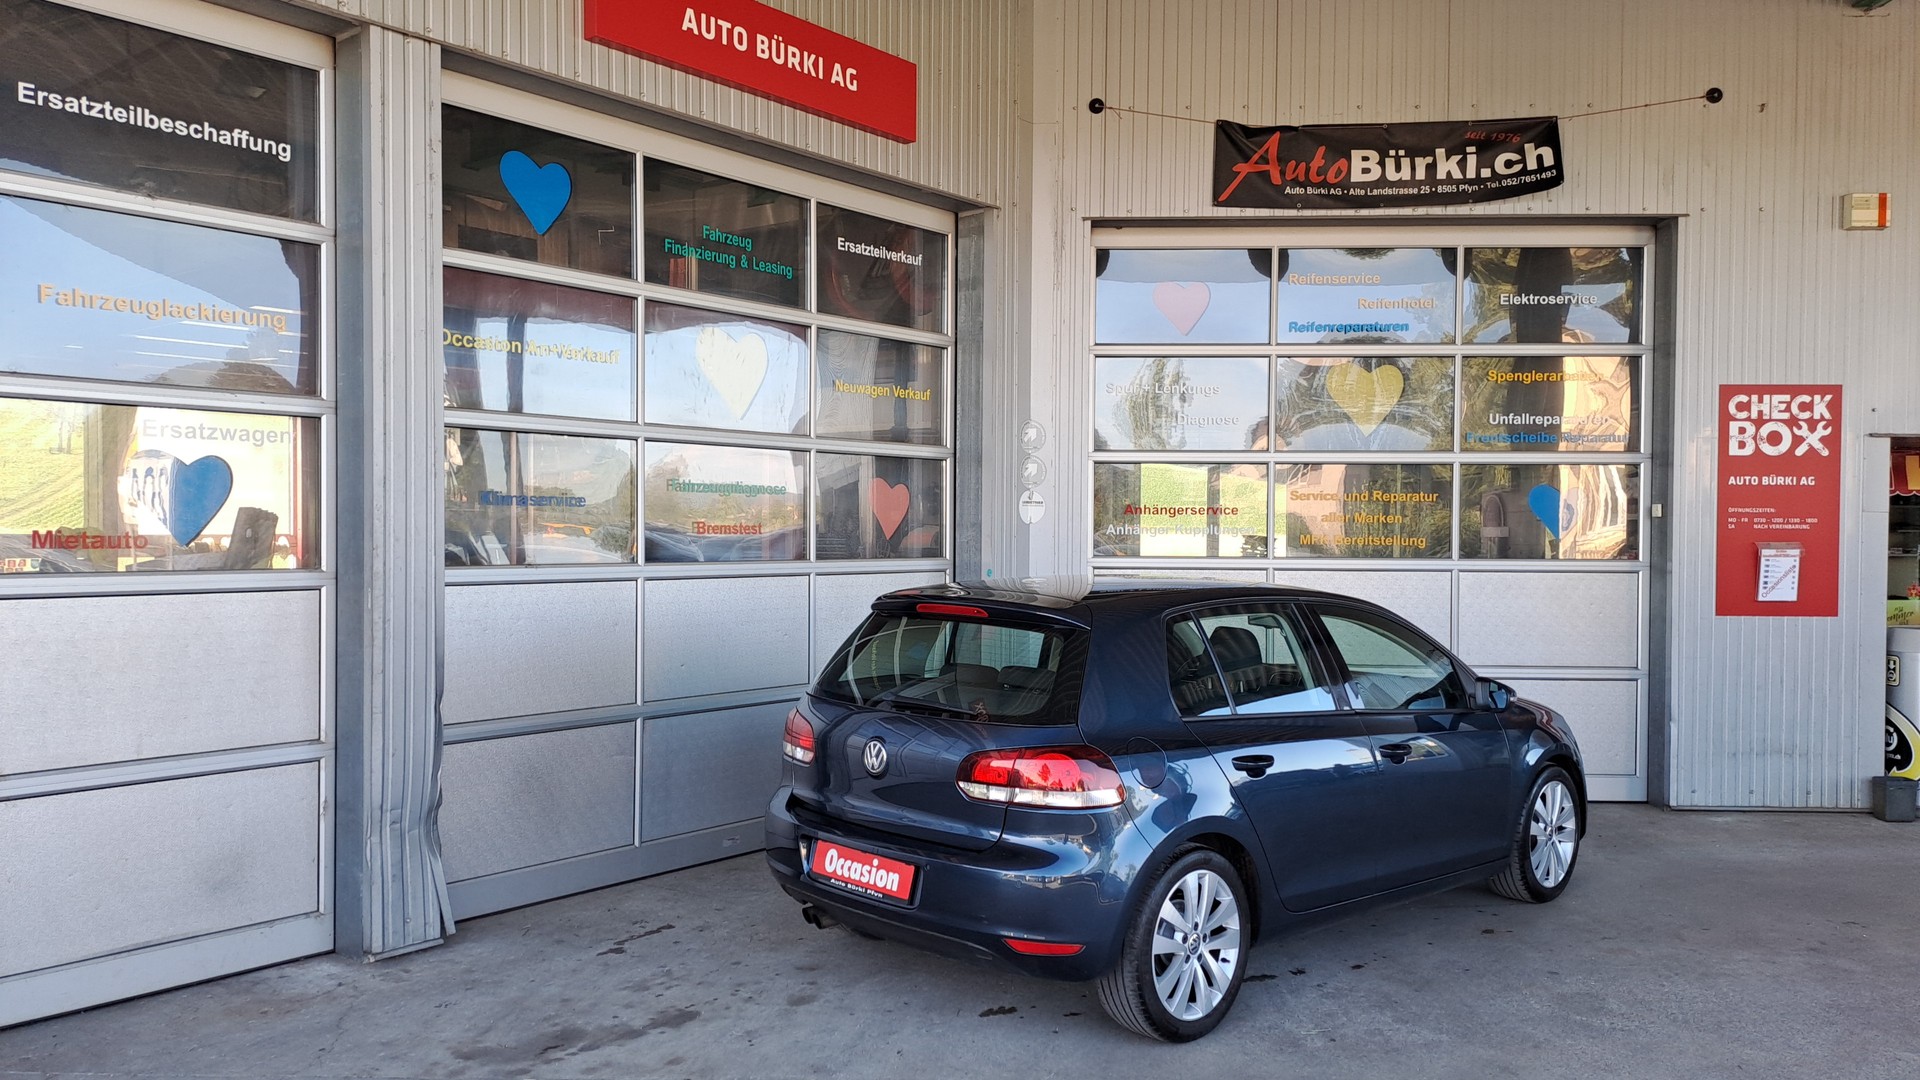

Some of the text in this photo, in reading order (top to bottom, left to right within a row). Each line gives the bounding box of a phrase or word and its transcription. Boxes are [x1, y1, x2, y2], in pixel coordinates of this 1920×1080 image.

[681, 7, 858, 92] AUTO BÜRKI AG
[17, 81, 292, 162] Ersatzteilbeschaffung
[1465, 130, 1521, 143] seit 1976
[1284, 186, 1305, 195] Auto
[1306, 186, 1328, 195] Bürki
[1329, 188, 1343, 196] AG
[1348, 187, 1366, 196] Alte
[1367, 186, 1419, 196] Landstrasse
[1420, 185, 1431, 194] 25
[1437, 184, 1457, 193] 8505
[1459, 184, 1479, 193] Pfyn
[702, 224, 753, 252] Fahrzeug
[837, 236, 923, 266] Ersatzteilverkauf
[664, 238, 793, 280] Finanzierung & Leasing
[1288, 272, 1381, 286] Reifenservice
[1357, 297, 1436, 310] Reifenhotel
[1500, 293, 1598, 306] Elektroservice
[37, 282, 287, 333] Fahrzeuglackierung
[1288, 320, 1410, 334] Reifenreparaturen
[834, 379, 931, 401] Neuwagen Verkauf
[1105, 383, 1140, 396] Spur
[1155, 383, 1221, 396] Lenkungs
[1728, 394, 1833, 420] CHECK
[1176, 413, 1240, 427] Diagnose
[142, 418, 291, 447] Ersatzwagen
[1728, 420, 1832, 457] BOX
[1728, 474, 1816, 486] AUTO BÜRKI AG
[1289, 490, 1439, 503] Service und Reparatur
[1123, 503, 1239, 518] Anhängerservice
[1321, 513, 1403, 524] aller Marken
[692, 521, 763, 535] Bremstest
[1105, 524, 1256, 538] Anhänger Kupplungen
[31, 530, 149, 550] Mietauto
[1333, 534, 1427, 548] Bereitstellung
[824, 848, 900, 892] Occasion
[830, 878, 846, 887] Auto
[847, 883, 865, 893] Bürki
